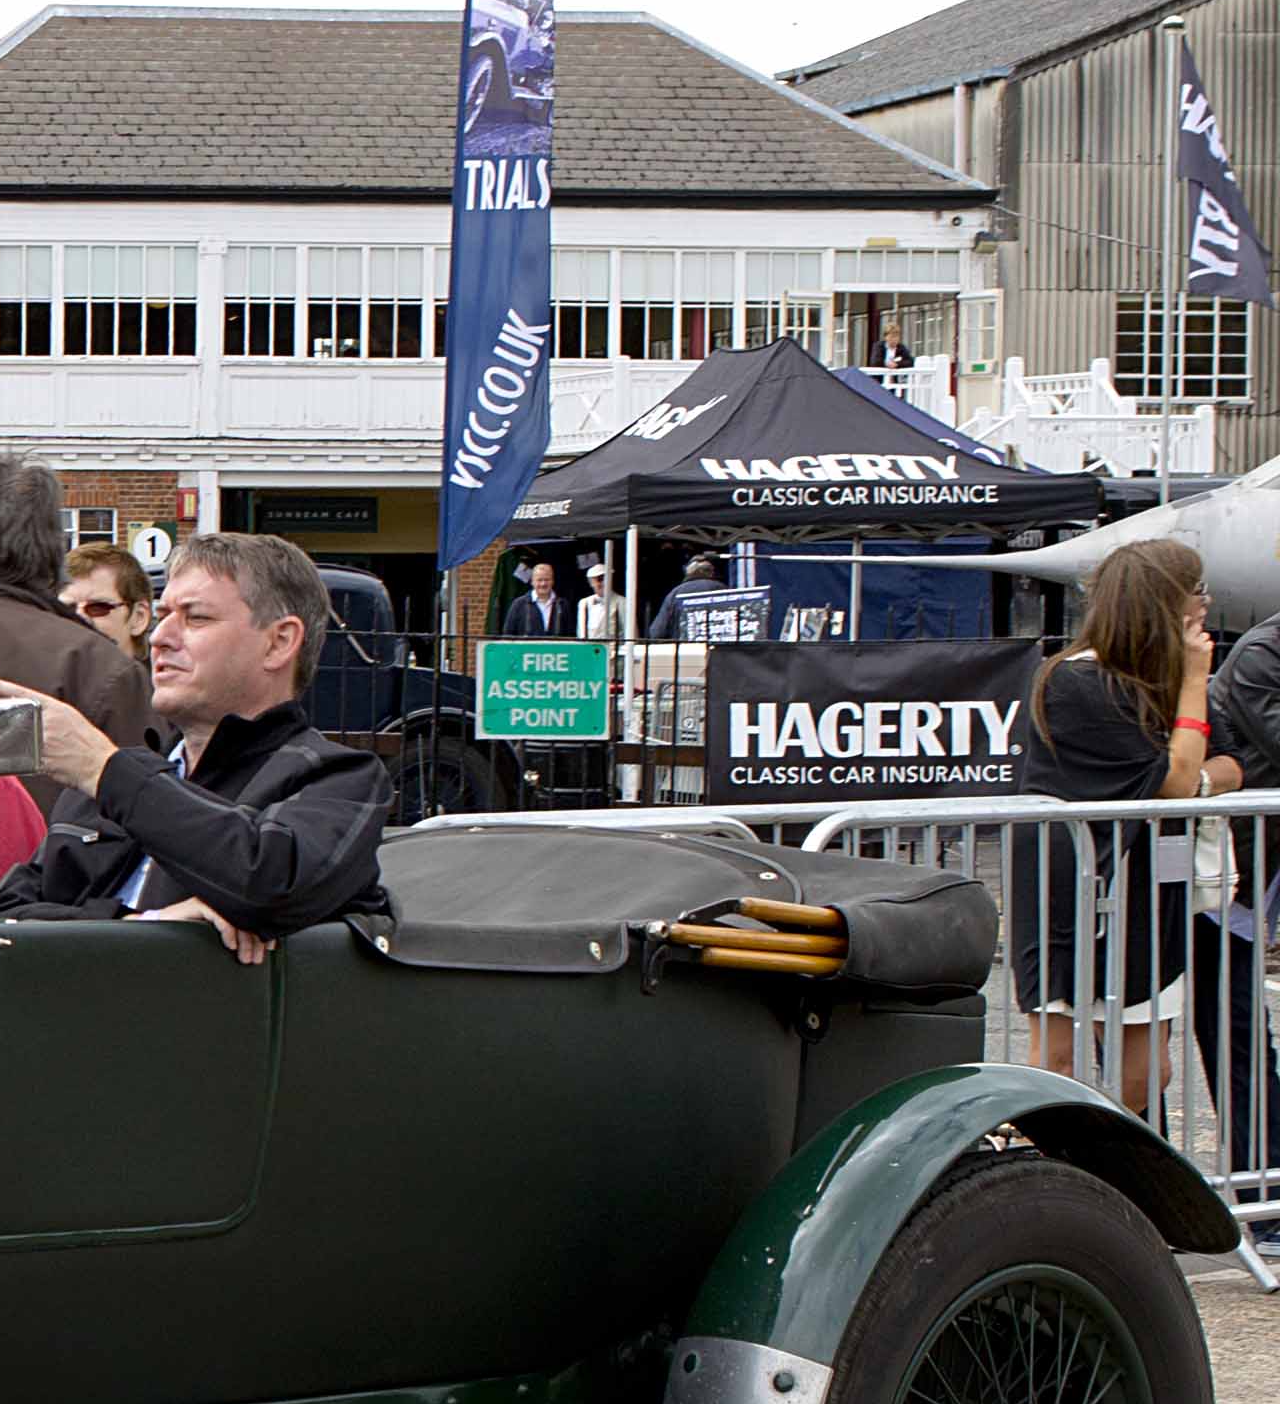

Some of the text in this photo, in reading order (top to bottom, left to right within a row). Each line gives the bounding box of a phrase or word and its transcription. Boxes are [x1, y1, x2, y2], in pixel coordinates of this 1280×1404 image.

[464, 158, 552, 211] TRIALS
[449, 308, 552, 490] VSCC.CO.UK
[701, 453, 960, 481] HAGERTY
[732, 484, 999, 506] CLASSIC CAR INSURANCE
[145, 535, 157, 558] 1
[522, 652, 569, 672] FIRE
[488, 679, 603, 699] ASSEMBLY
[509, 708, 579, 728] POINT
[730, 700, 1021, 758] HAGERTY
[731, 764, 1013, 785] CLASSIC CAR INSURANCE
